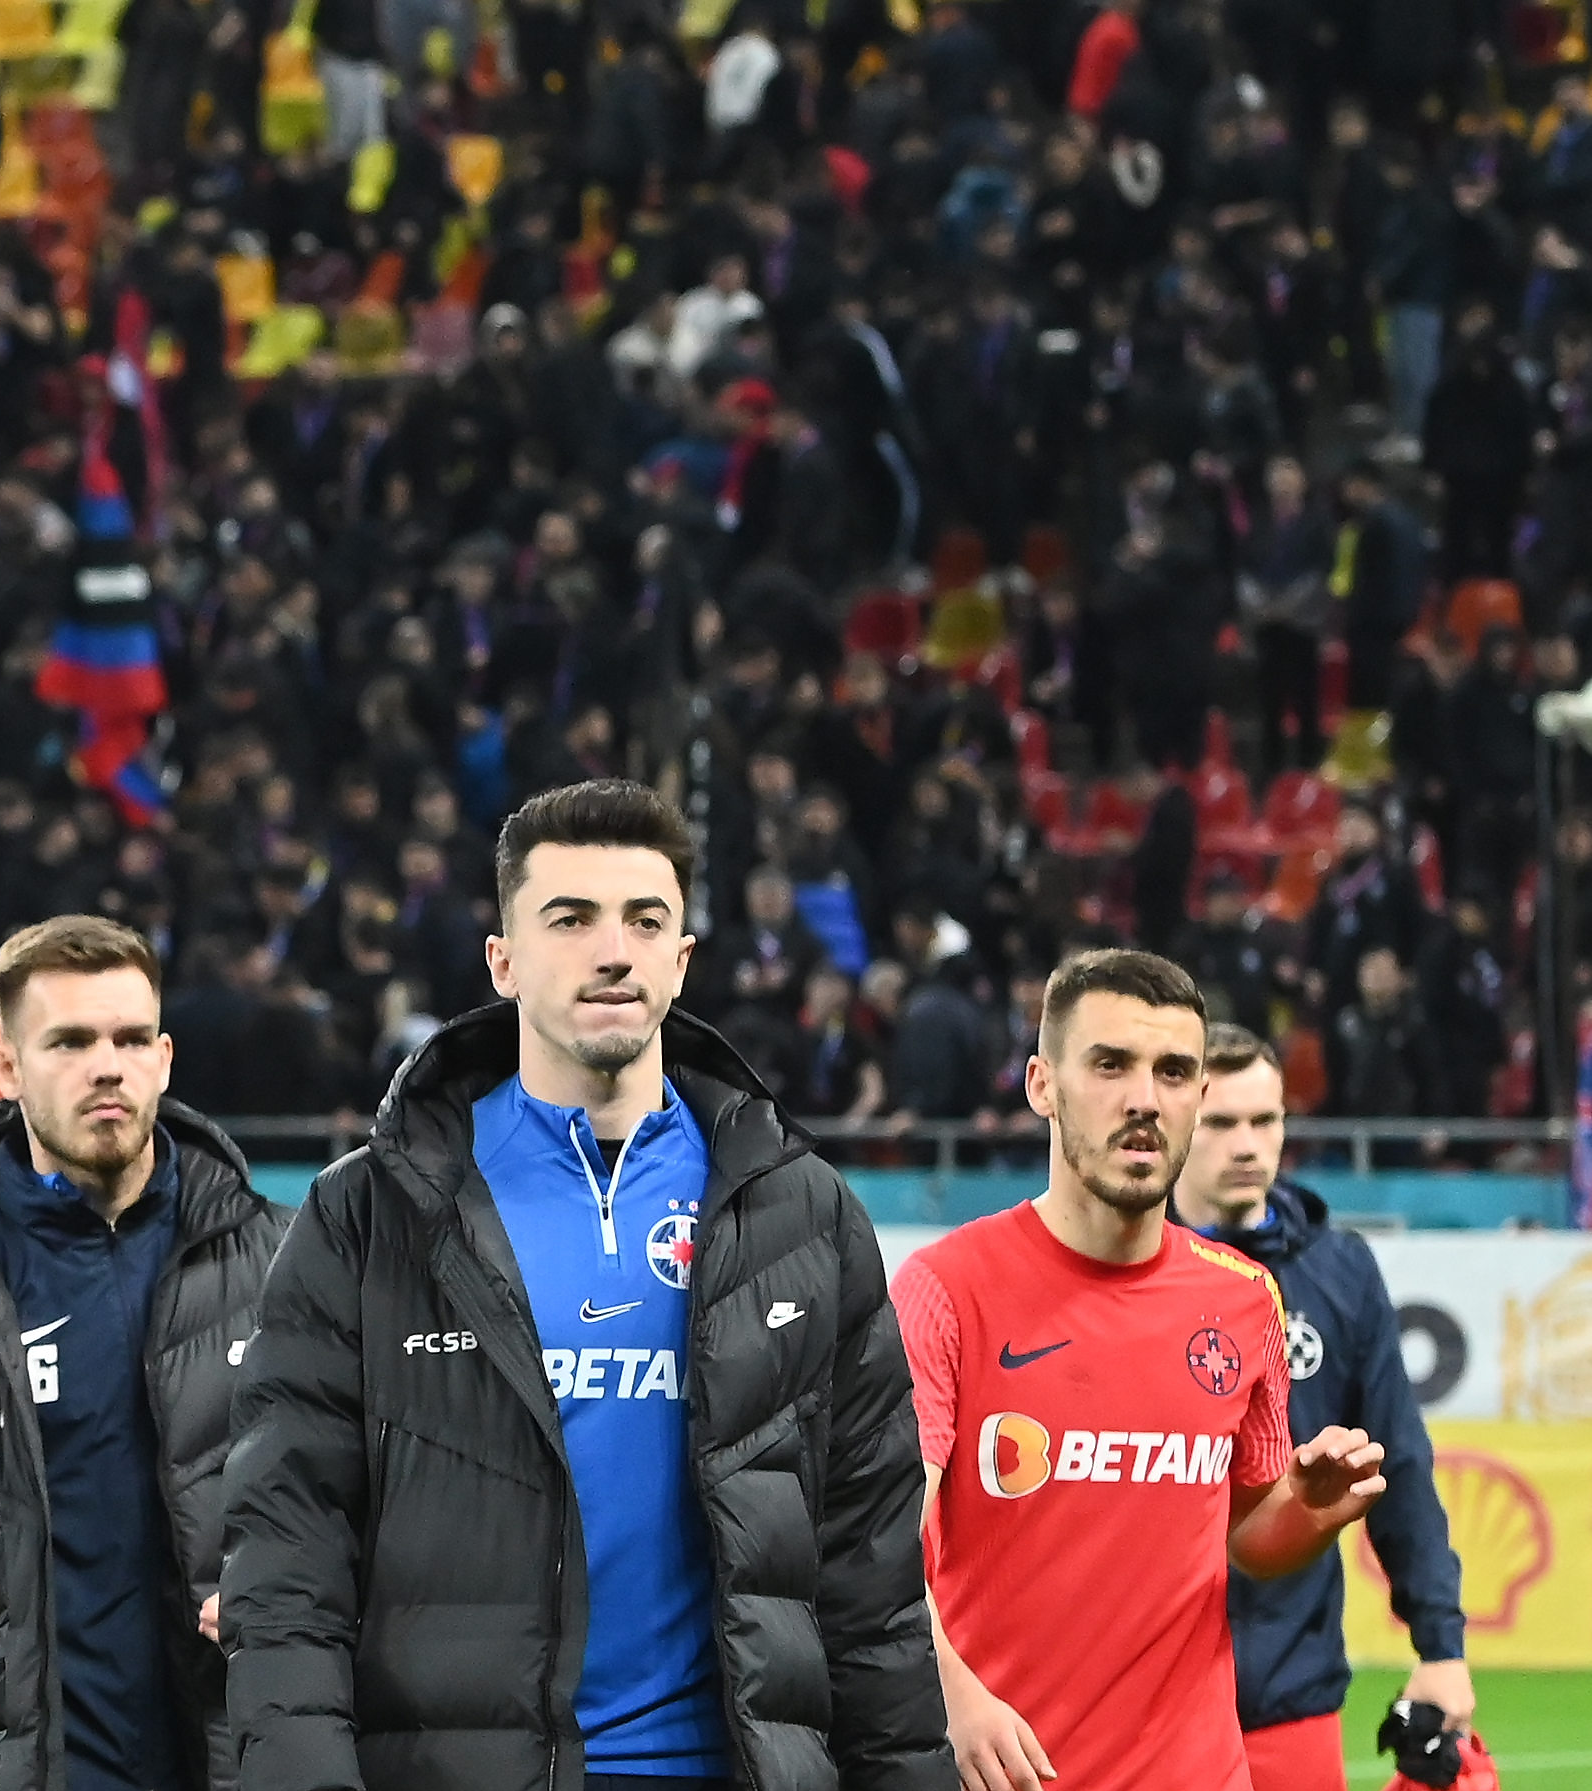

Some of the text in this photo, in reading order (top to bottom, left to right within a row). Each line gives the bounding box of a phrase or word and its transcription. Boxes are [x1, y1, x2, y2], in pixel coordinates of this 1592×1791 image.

[402, 1330, 479, 1355] FCSB
[26, 1343, 59, 1404] 6
[1053, 1430, 1233, 1485] BETANO
